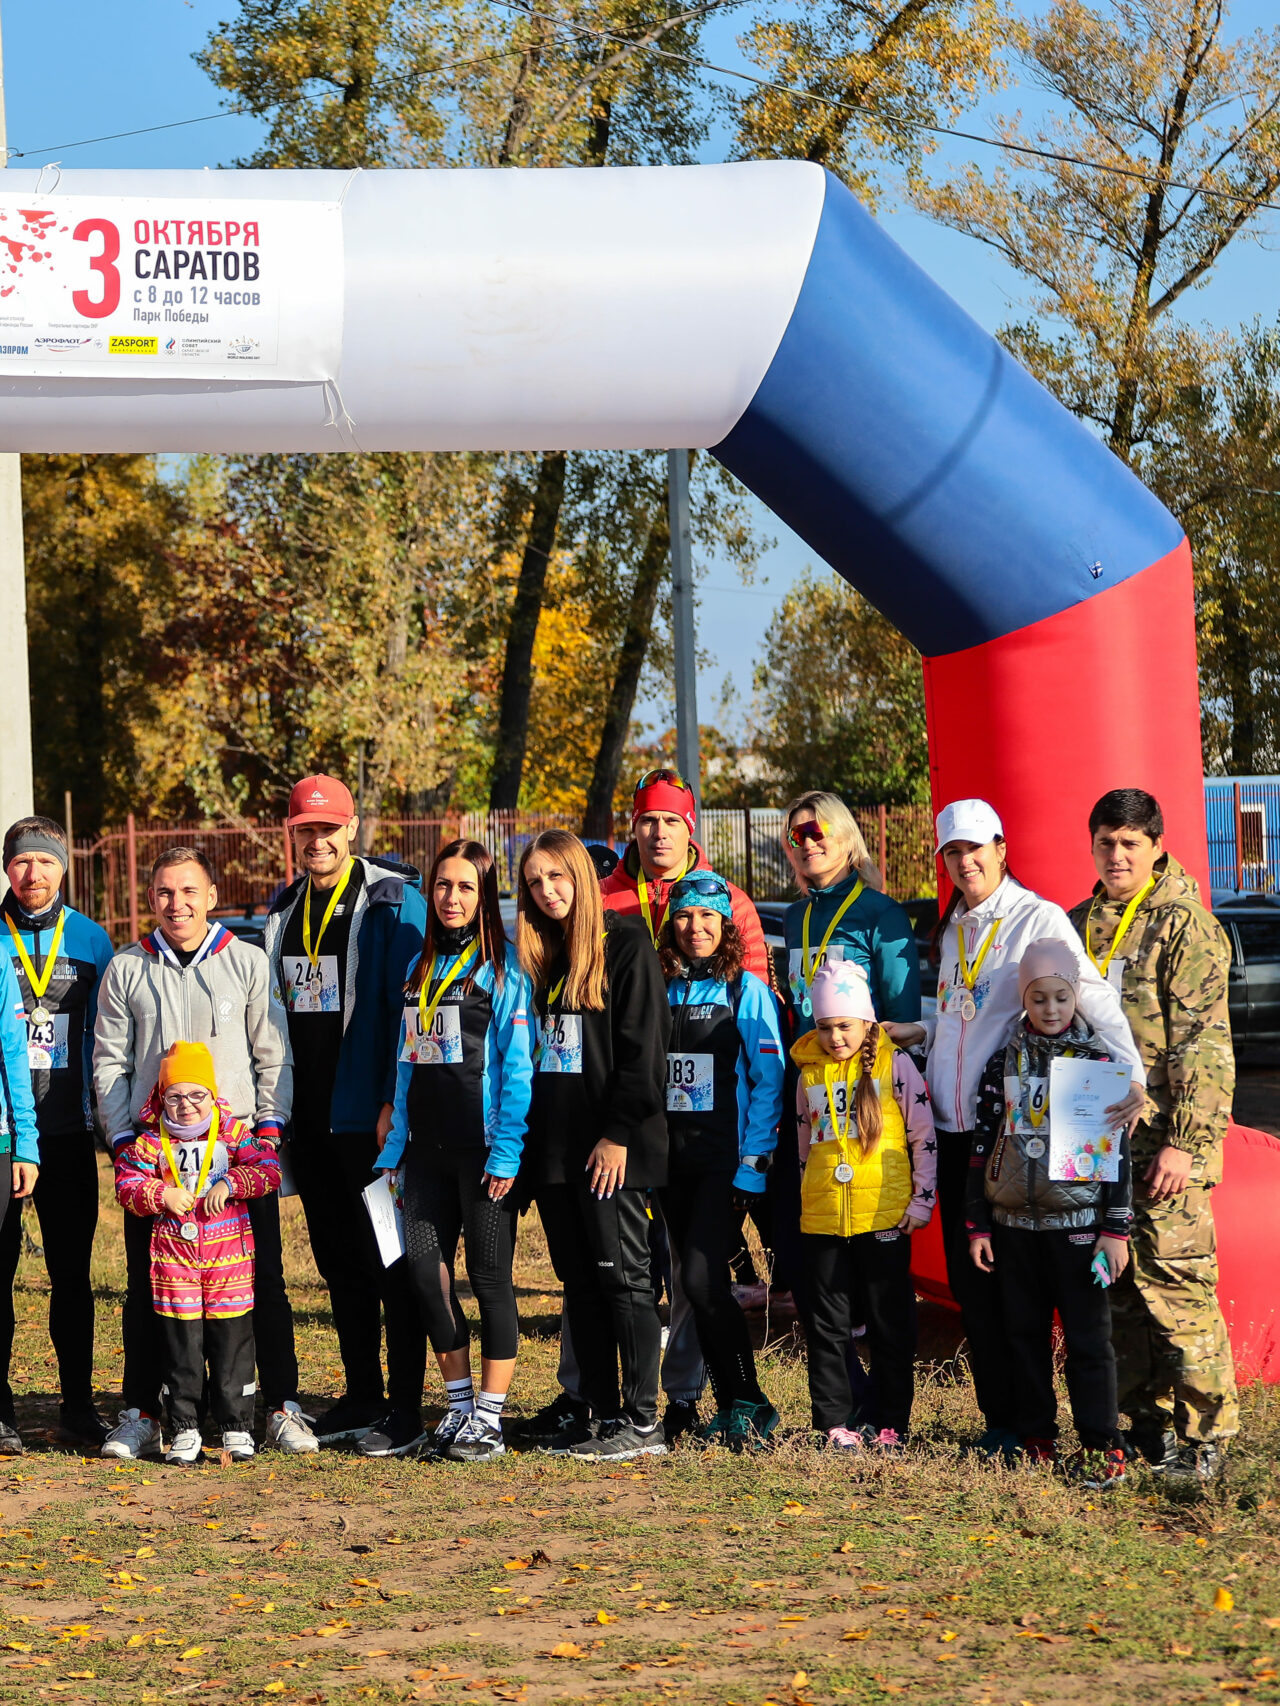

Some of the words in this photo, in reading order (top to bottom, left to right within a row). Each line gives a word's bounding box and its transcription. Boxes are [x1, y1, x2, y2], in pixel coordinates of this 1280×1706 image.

[134, 219, 260, 246] ОКТЯБРЯ
[72, 218, 120, 318] 3
[135, 249, 260, 281] САРАТОВ
[133, 289, 143, 303] с
[148, 285, 157, 303] 8
[163, 290, 183, 306] до
[190, 286, 208, 304] 12
[214, 291, 261, 305] часов
[133, 308, 161, 324] Парк
[165, 309, 209, 324] Победы
[111, 339, 156, 348] ZASPORT
[26, 1020, 54, 1044] 43
[178, 1147, 214, 1172] 21
